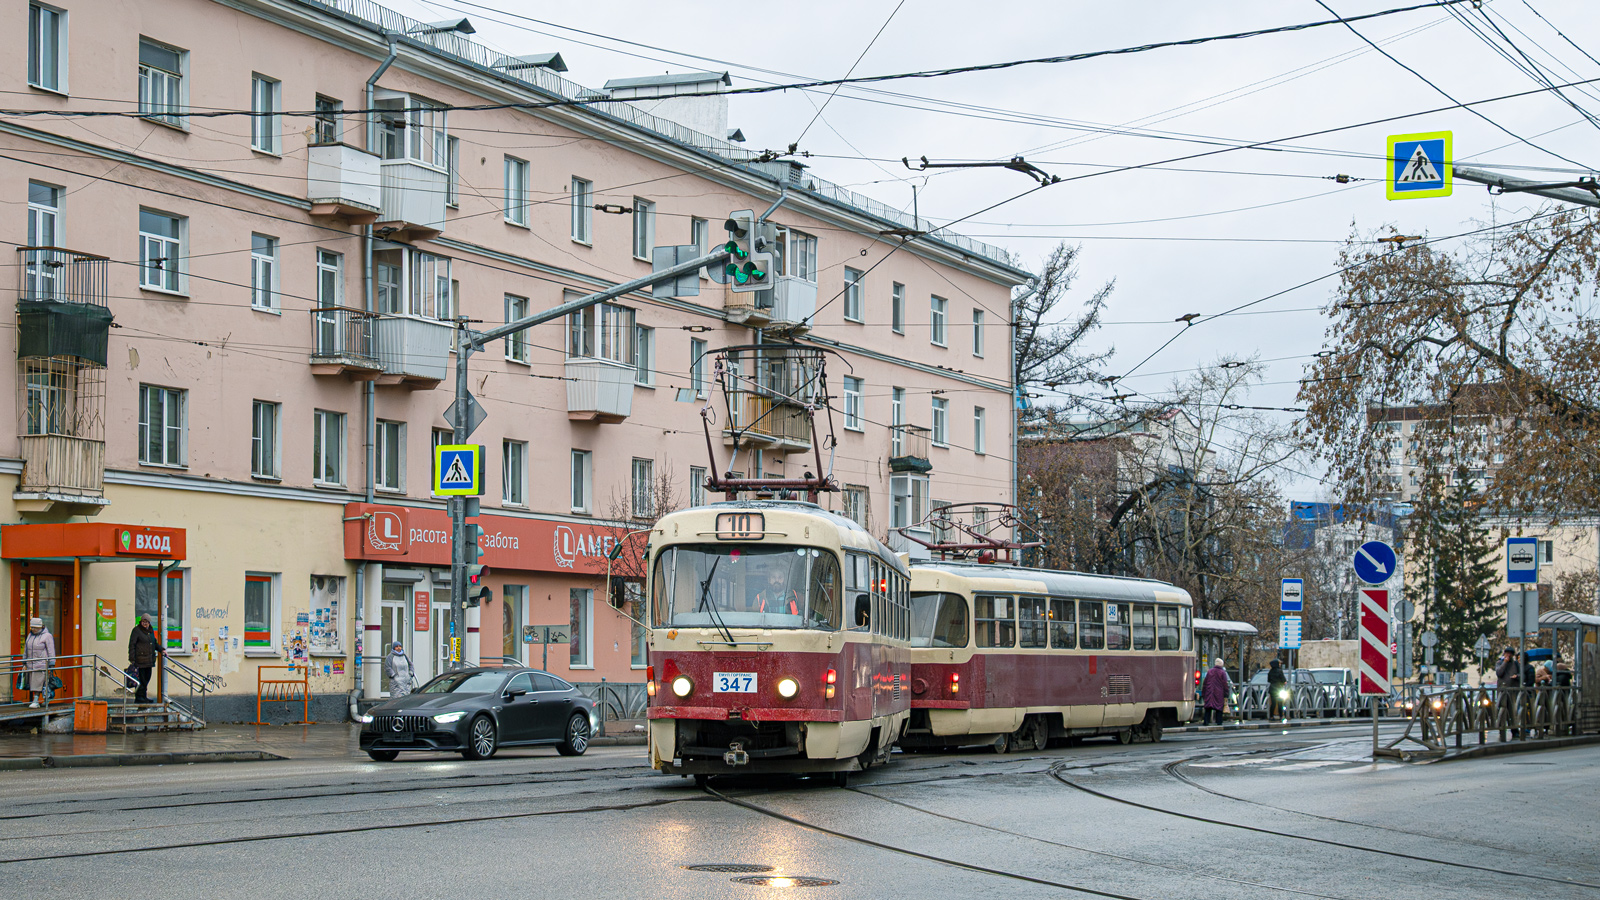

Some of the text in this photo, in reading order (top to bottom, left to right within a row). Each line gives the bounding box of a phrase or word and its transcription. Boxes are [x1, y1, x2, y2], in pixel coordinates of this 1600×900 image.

[728, 514, 751, 537] 10
[136, 534, 171, 553] ВХОД
[484, 532, 520, 550] забота
[719, 677, 753, 692] 347
